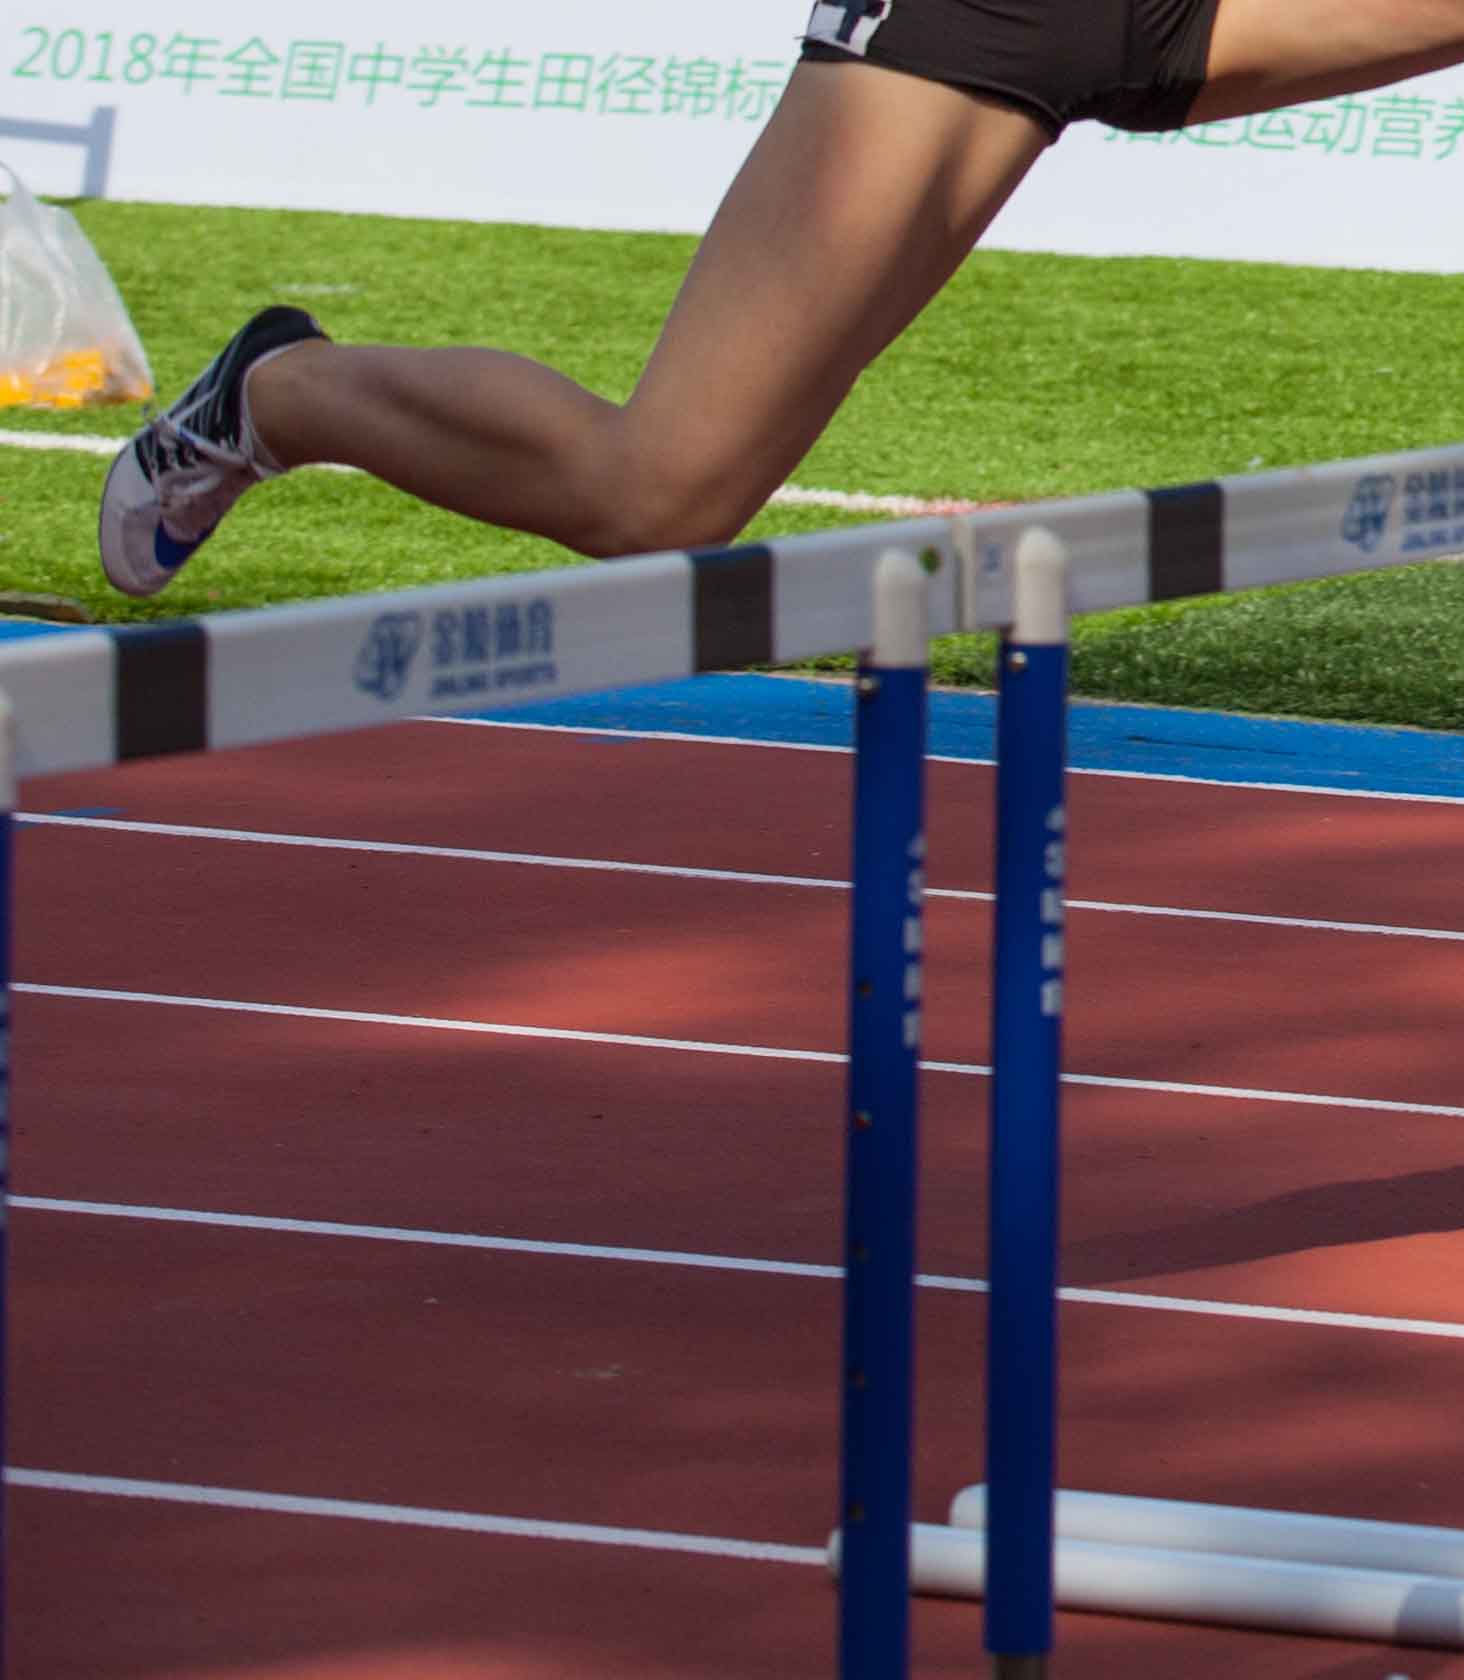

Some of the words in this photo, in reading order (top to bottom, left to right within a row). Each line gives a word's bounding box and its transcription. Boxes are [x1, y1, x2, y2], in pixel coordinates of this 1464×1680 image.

[11, 26, 785, 121] 2018年全国中学生田径锦标
